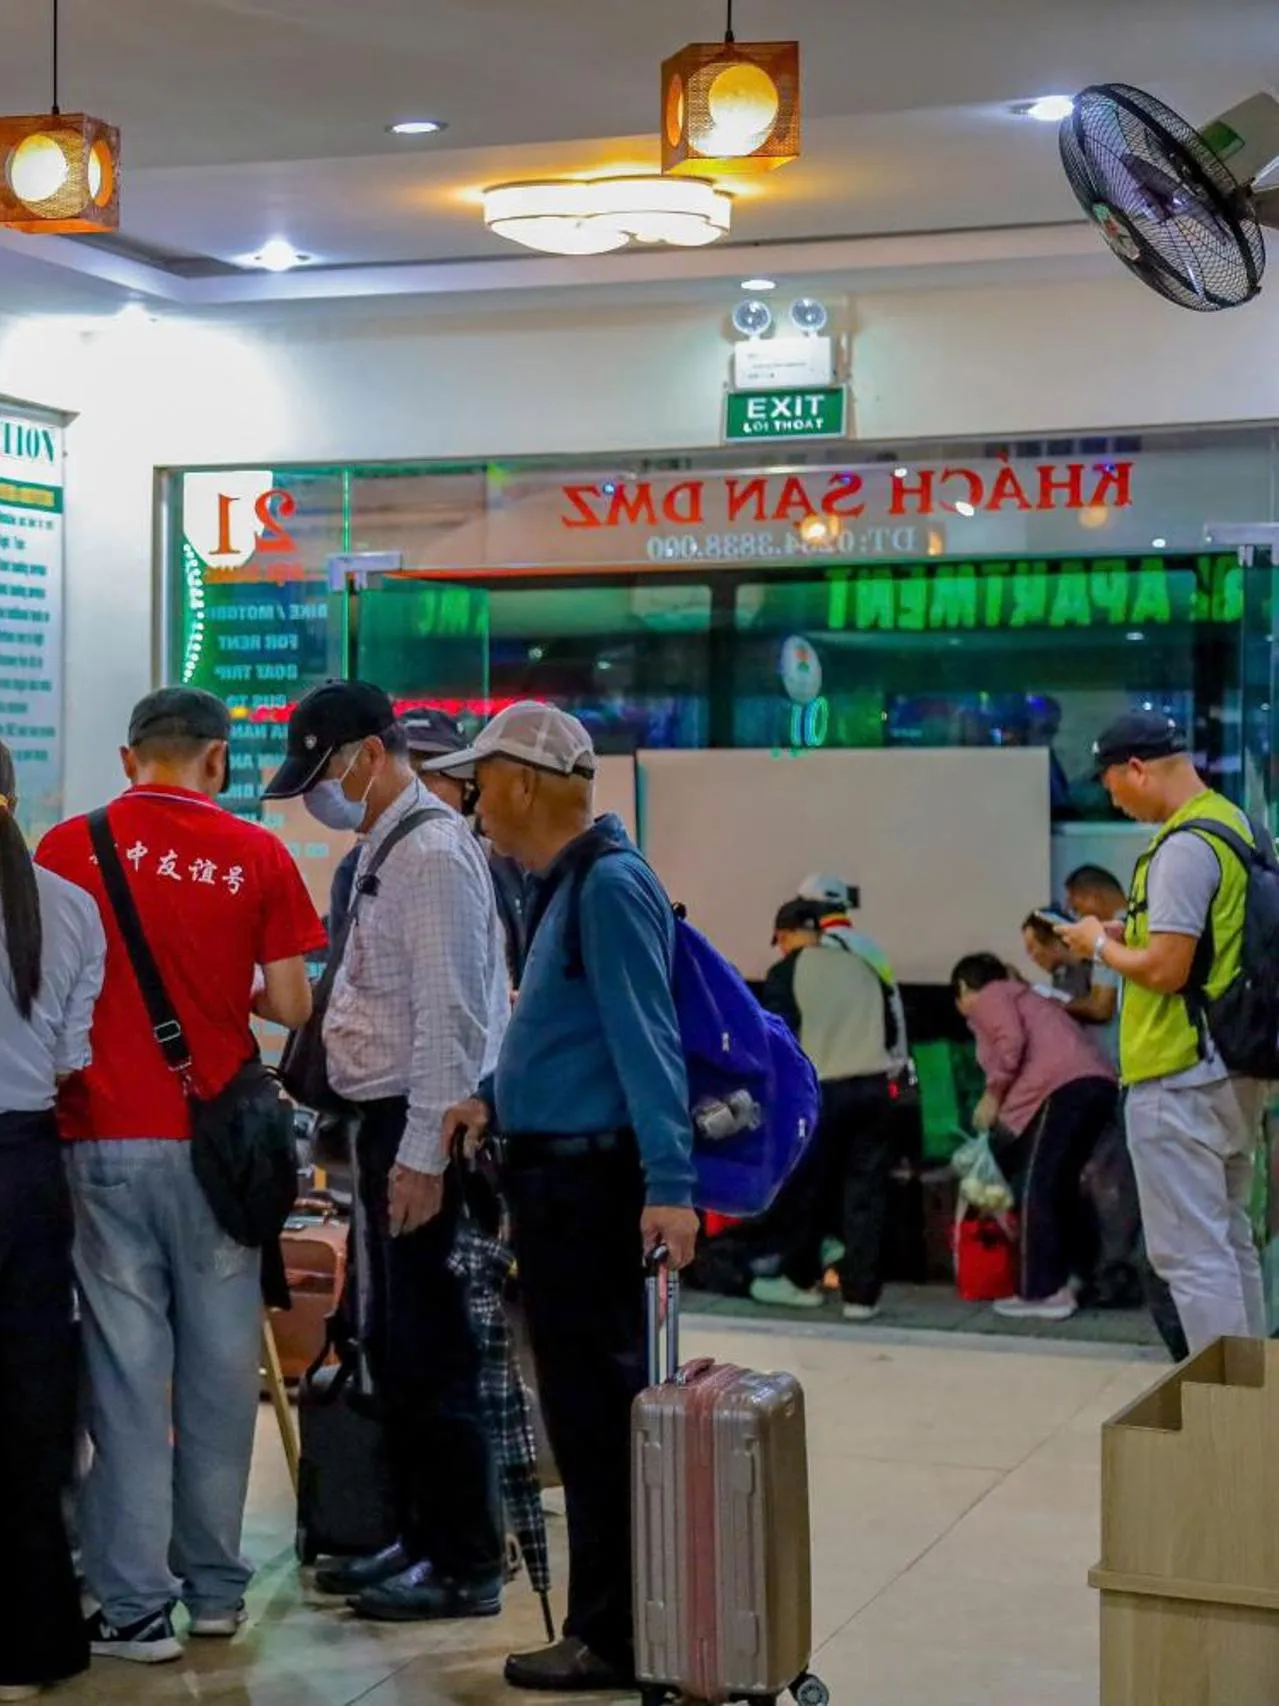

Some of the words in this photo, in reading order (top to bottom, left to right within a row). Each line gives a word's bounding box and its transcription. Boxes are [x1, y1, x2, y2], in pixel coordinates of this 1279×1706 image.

[747, 395, 825, 419] EXIT
[89, 840, 245, 895] 中友谊号
